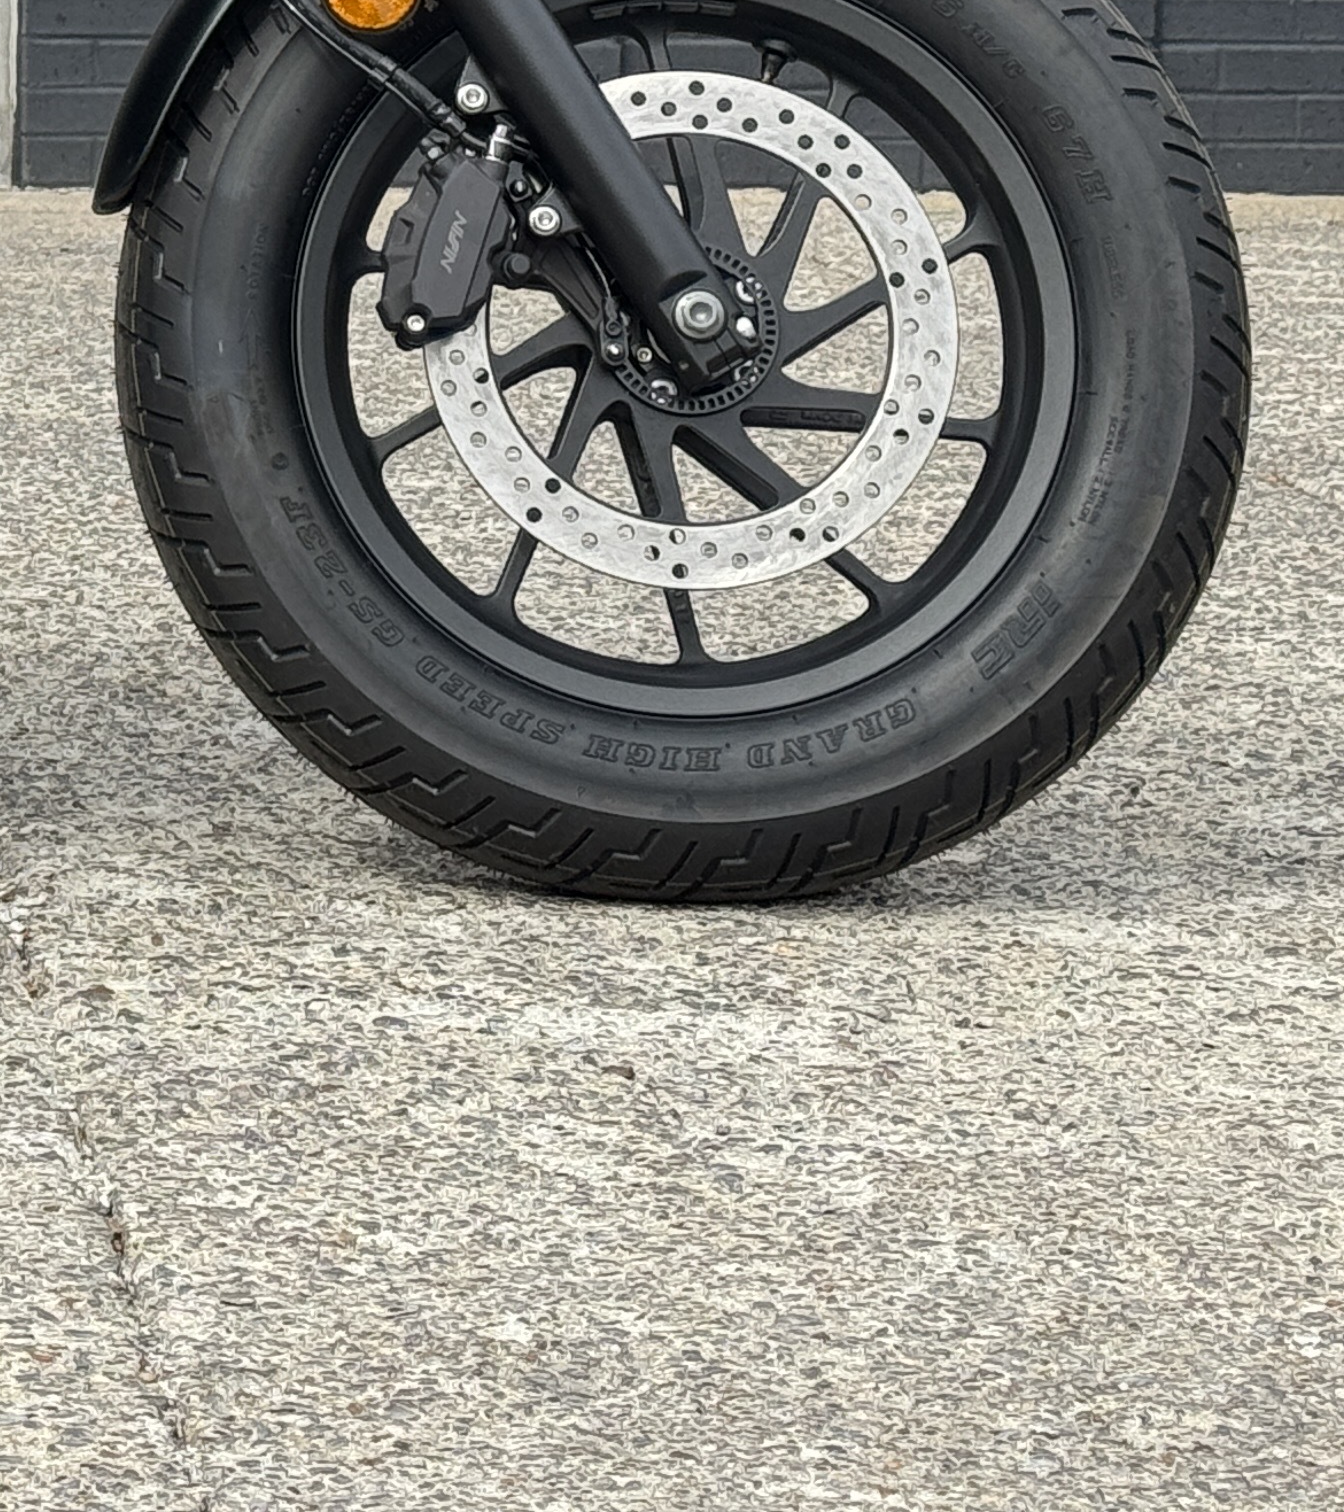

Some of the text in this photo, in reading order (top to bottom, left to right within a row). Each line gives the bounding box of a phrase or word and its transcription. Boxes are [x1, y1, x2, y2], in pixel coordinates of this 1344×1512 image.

[1043, 103, 1114, 206] 67H
[283, 495, 918, 775] GRAND HIGH SPEED GS-23F
